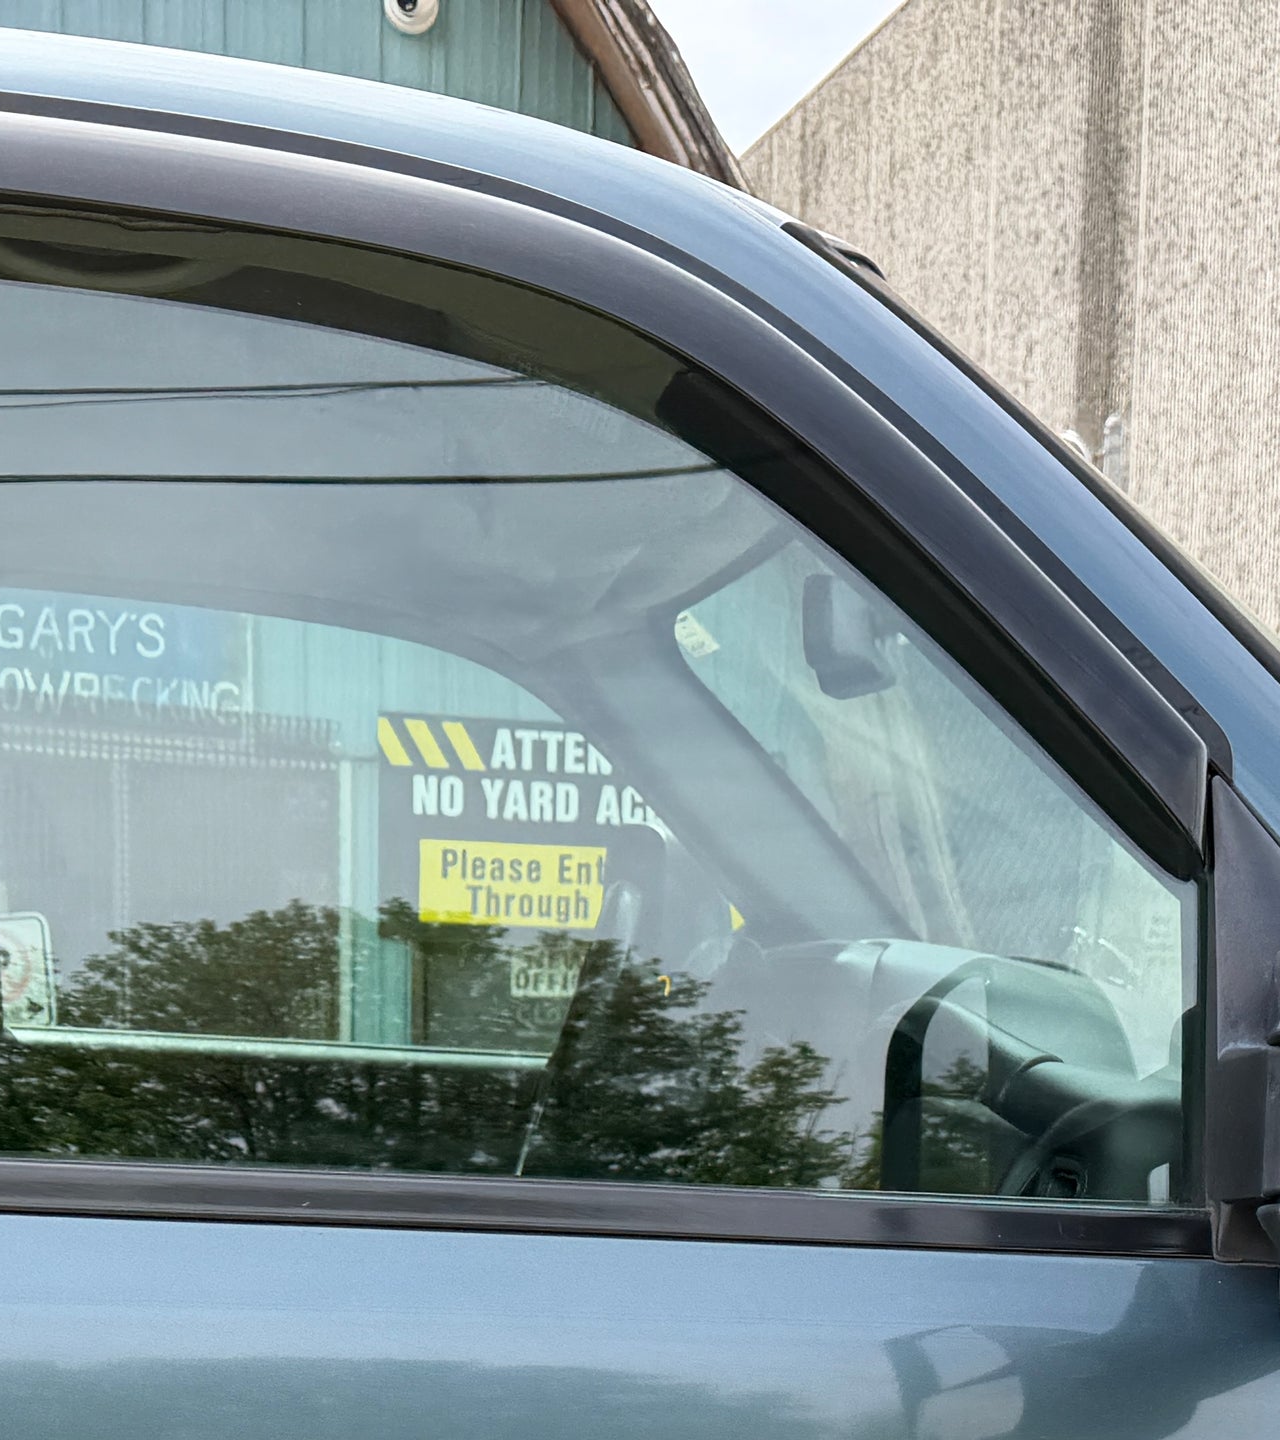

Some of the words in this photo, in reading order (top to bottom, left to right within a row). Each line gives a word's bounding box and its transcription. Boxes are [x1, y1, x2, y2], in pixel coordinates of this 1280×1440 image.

[413, 774, 463, 817] NO
[481, 778, 579, 823] YARD
[440, 848, 542, 884] Please
[466, 884, 589, 922] Through
